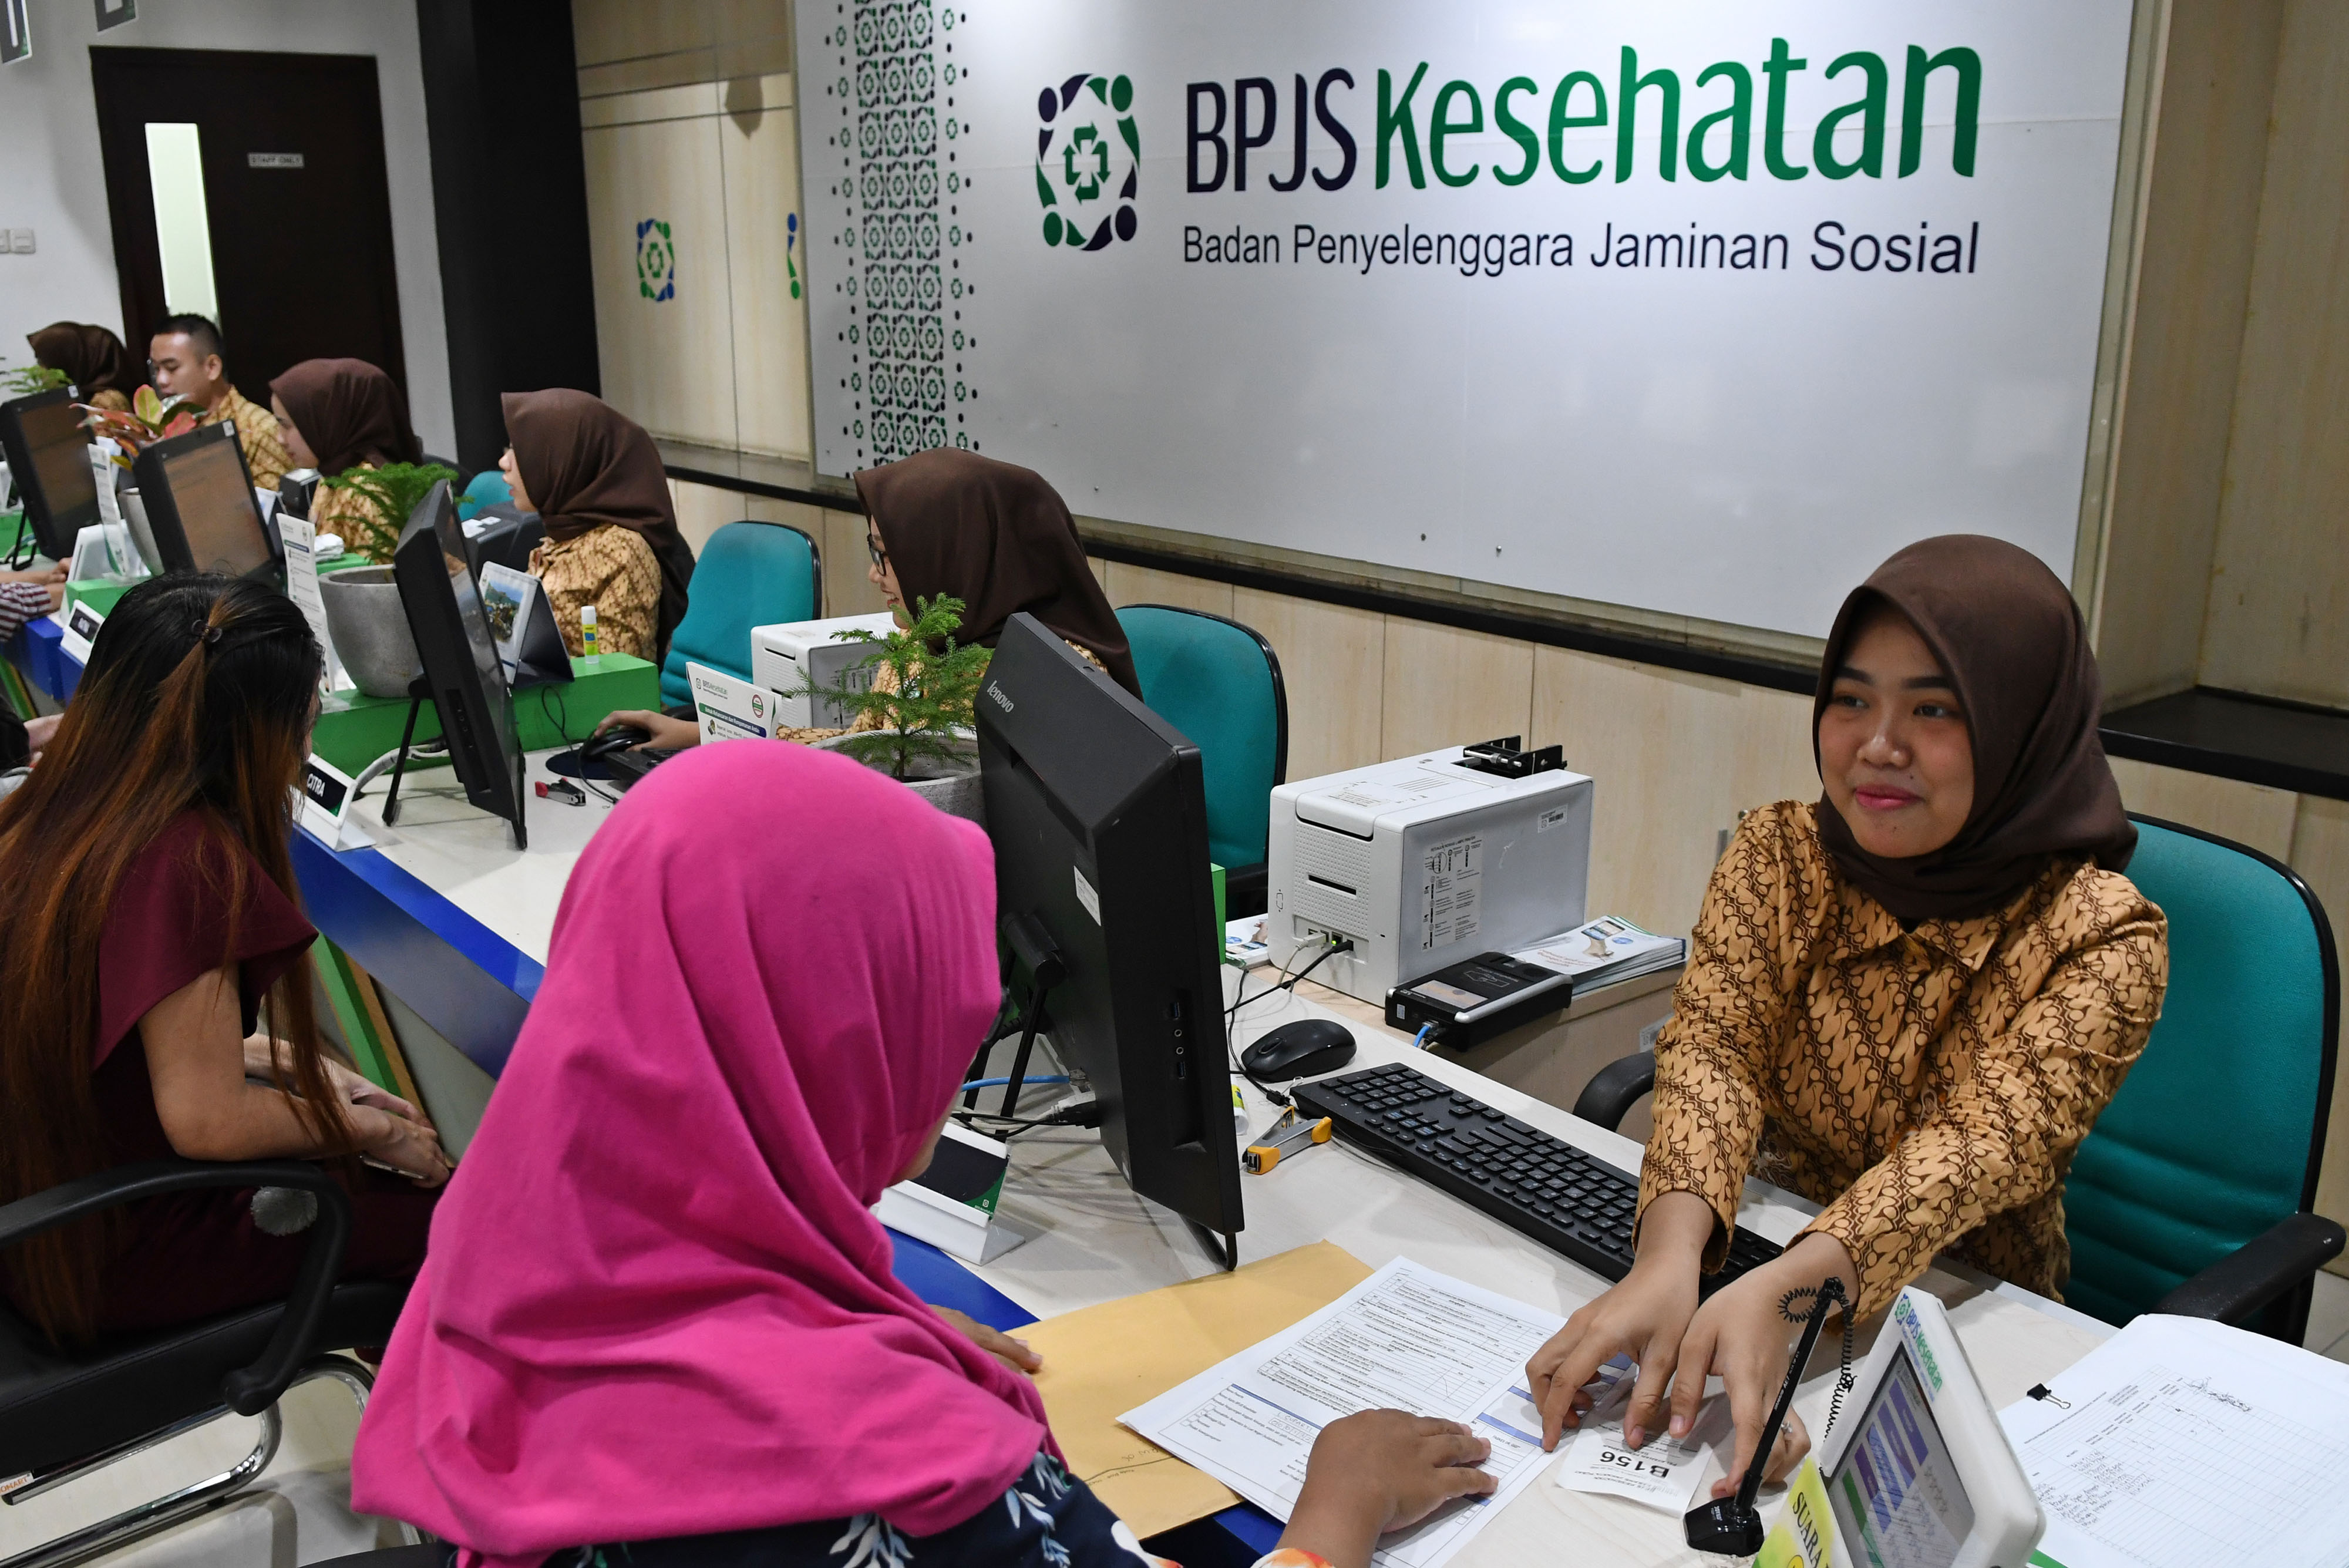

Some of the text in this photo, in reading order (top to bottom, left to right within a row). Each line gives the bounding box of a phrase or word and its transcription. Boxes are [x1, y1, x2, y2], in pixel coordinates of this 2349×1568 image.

[1187, 37, 1983, 193] BPJS Kesehatan
[1183, 220, 1979, 277] Badan Penyelenggara Jaminan Sosial
[987, 680, 1015, 713] lenovo
[307, 773, 325, 798] CITRA
[1906, 1308, 1921, 1339] BPJS
[1915, 1330, 1943, 1393] Kesehatan
[1600, 1451, 1670, 1479] B156
[1792, 1492, 1823, 1568] SUARA
